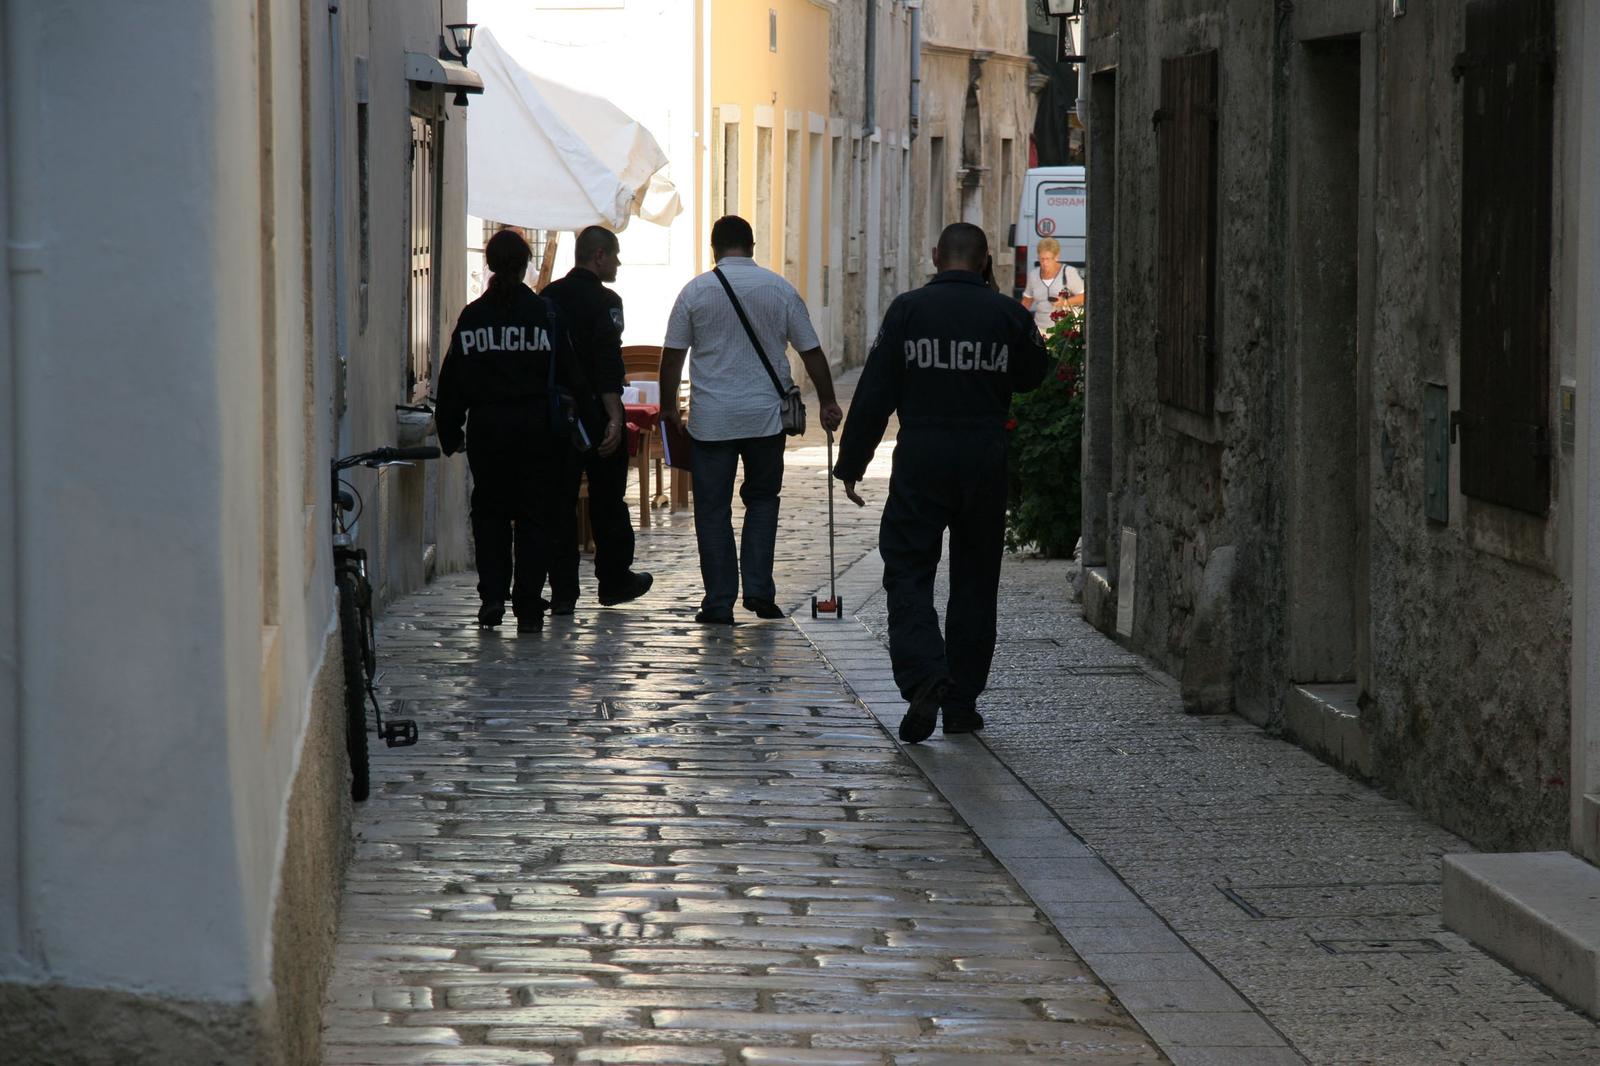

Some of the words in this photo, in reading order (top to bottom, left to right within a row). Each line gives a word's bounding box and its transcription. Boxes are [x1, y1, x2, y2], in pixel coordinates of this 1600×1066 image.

[1047, 197, 1085, 207] OSRAM
[460, 326, 551, 355] POLICIJA
[904, 338, 1008, 373] POLICIJA
